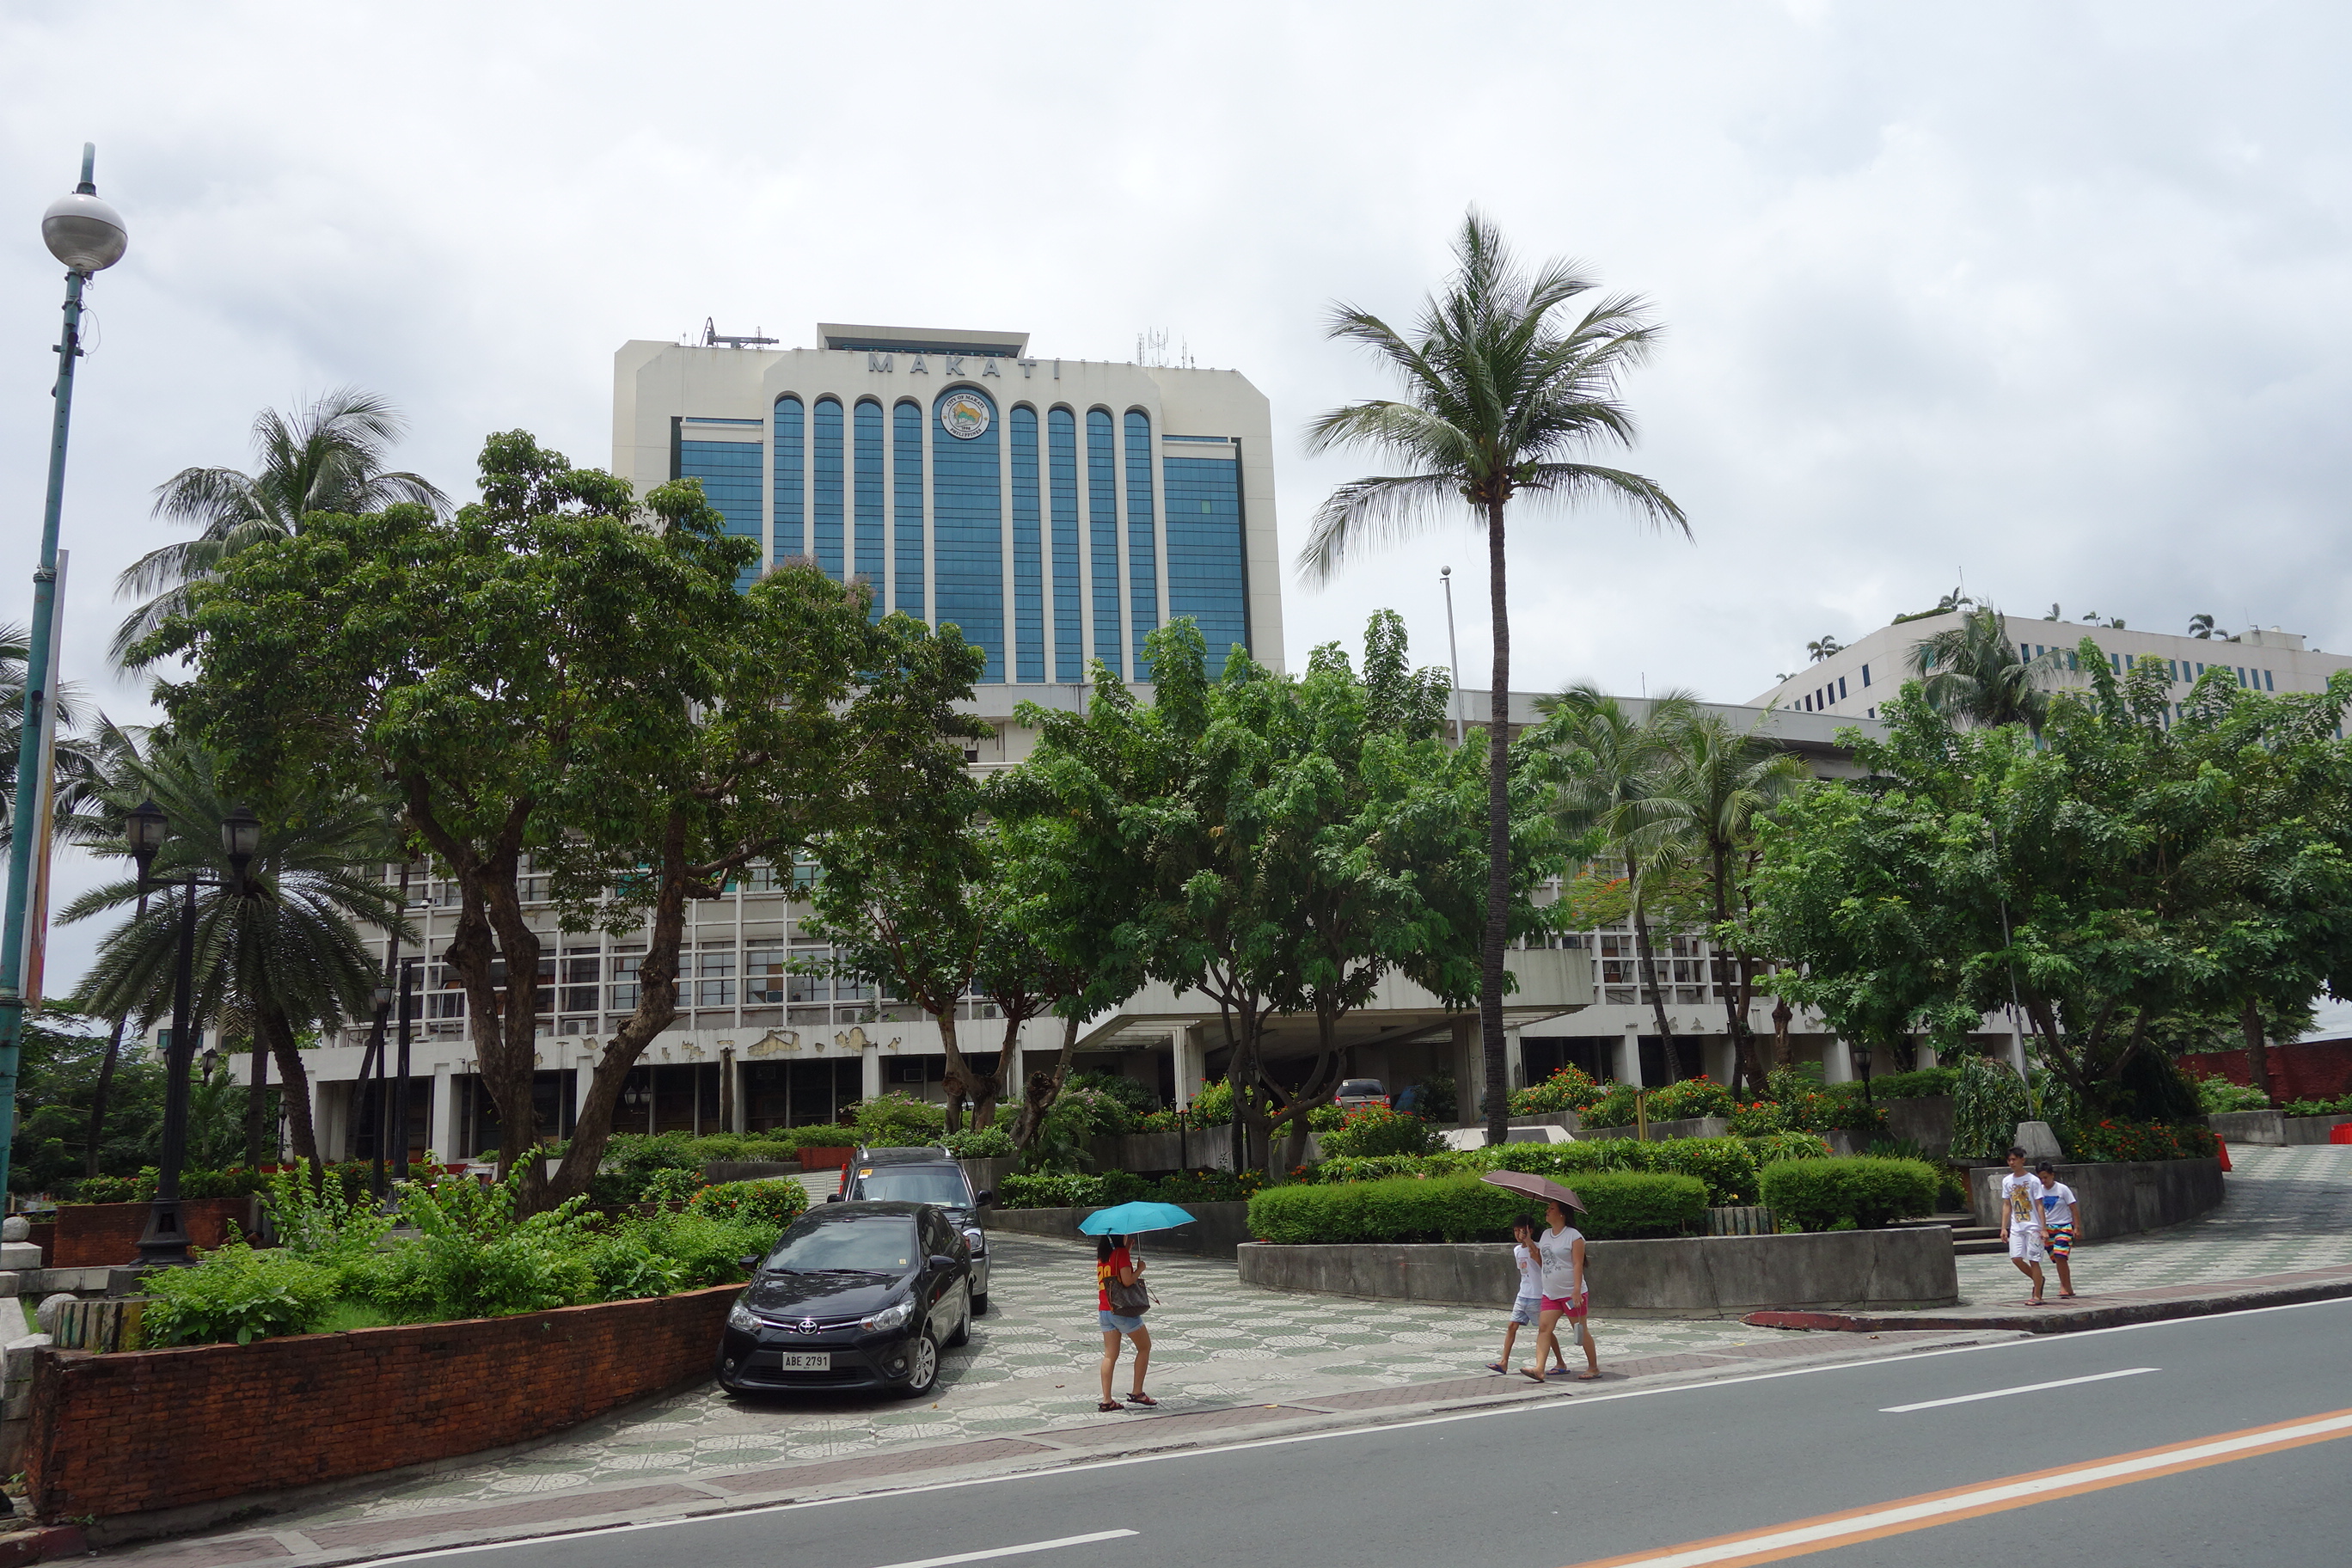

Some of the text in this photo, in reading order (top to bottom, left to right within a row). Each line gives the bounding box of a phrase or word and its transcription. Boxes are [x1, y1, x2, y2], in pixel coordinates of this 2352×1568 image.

[868, 352, 1060, 379] MAKATI
[946, 397, 957, 407] CITY
[965, 395, 985, 408] MAKATI
[949, 427, 982, 437] PHILIPPINES
[786, 1356, 827, 1366] ABE 2791
